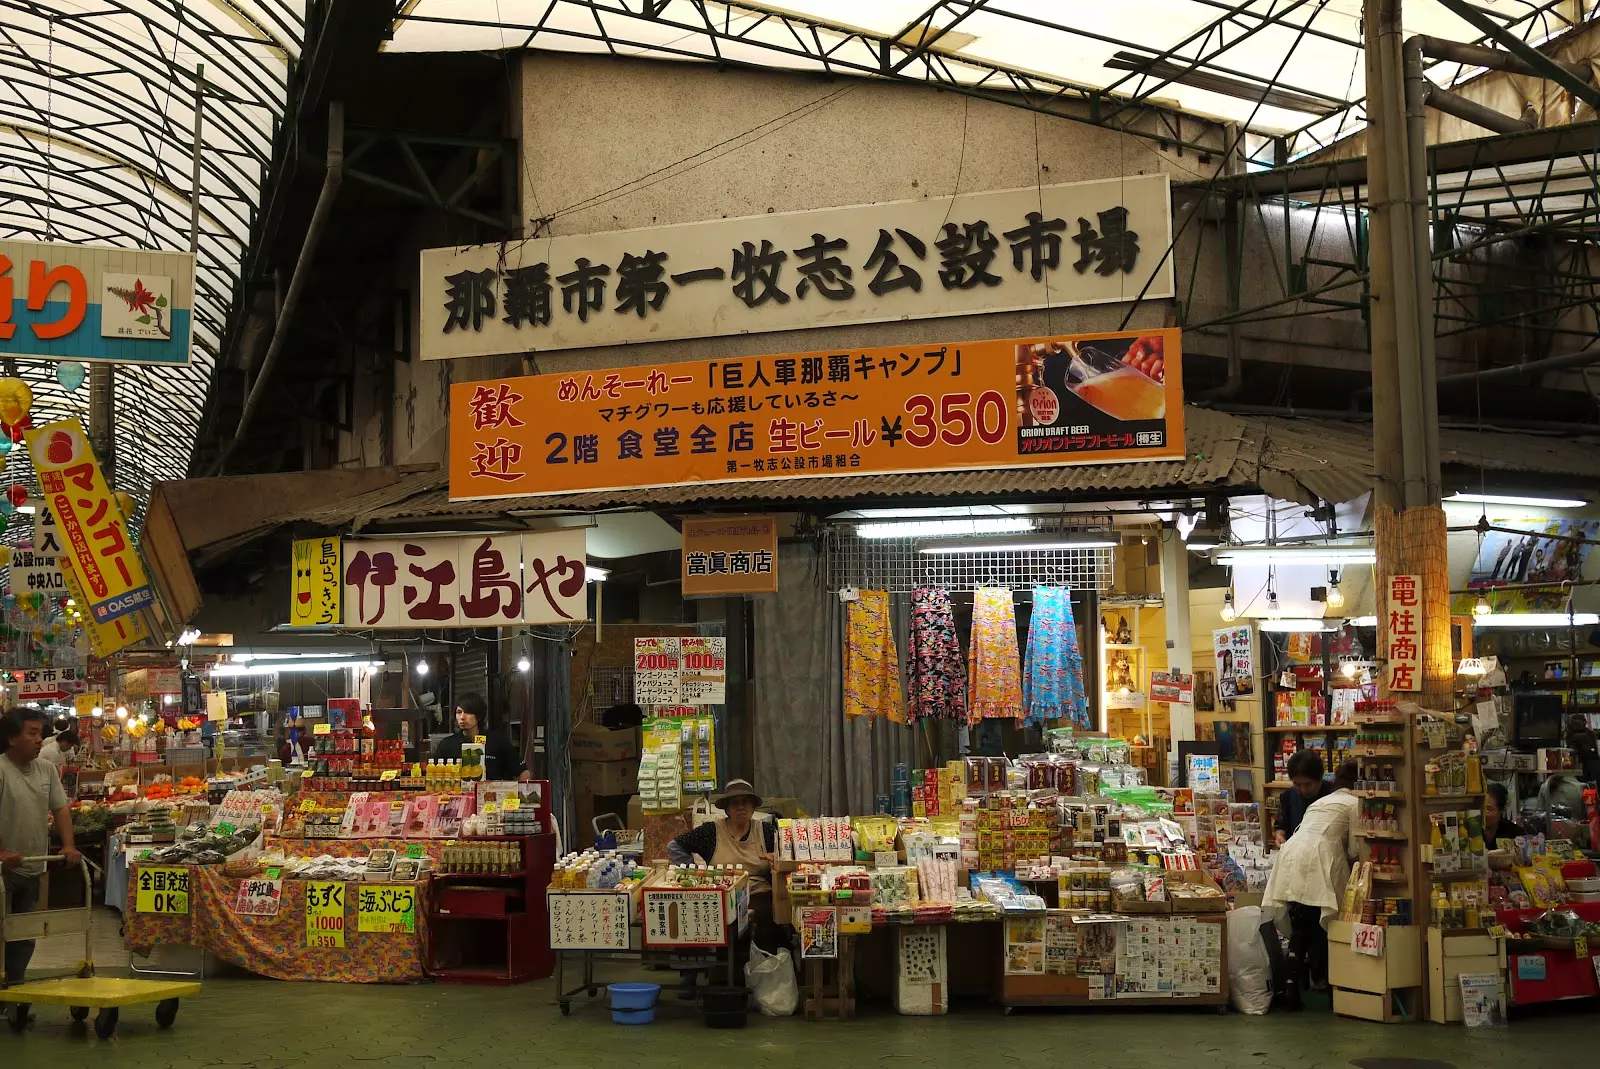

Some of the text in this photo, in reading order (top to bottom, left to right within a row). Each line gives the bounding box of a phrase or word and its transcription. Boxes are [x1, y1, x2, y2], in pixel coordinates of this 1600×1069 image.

[443, 205, 1141, 334] 那覇市第一牧志公設市場
[707, 346, 962, 390] 「巨人軍那覇キャンプ」
[557, 368, 694, 403] めんそーれー
[1032, 397, 1057, 410] Orion
[468, 383, 527, 483] 歓迎
[767, 416, 878, 453] 生ビール
[1021, 425, 1090, 438] ORION DRAFT BEER
[726, 453, 862, 474] 第一牧志公設市場組合
[63, 462, 133, 588] マンゴー
[27, 571, 63, 590] 中央入口
[319, 537, 339, 625] 島らっきょう
[345, 536, 586, 625] 伊江島や
[1388, 576, 1419, 690] 電柱商店
[635, 653, 680, 671] 200円
[684, 653, 725, 671] 100円
[1236, 659, 1250, 669] 紹介
[636, 671, 679, 679] マンゴージュース
[636, 679, 673, 687] グァバジュース
[23, 683, 56, 692] 出入口
[636, 687, 679, 696] ゴーヤージュース
[636, 696, 673, 704] すももジュース
[139, 870, 190, 893] 全国発送
[154, 893, 177, 912] OK
[307, 884, 342, 907] もずく
[359, 889, 413, 913] 海ぶどう
